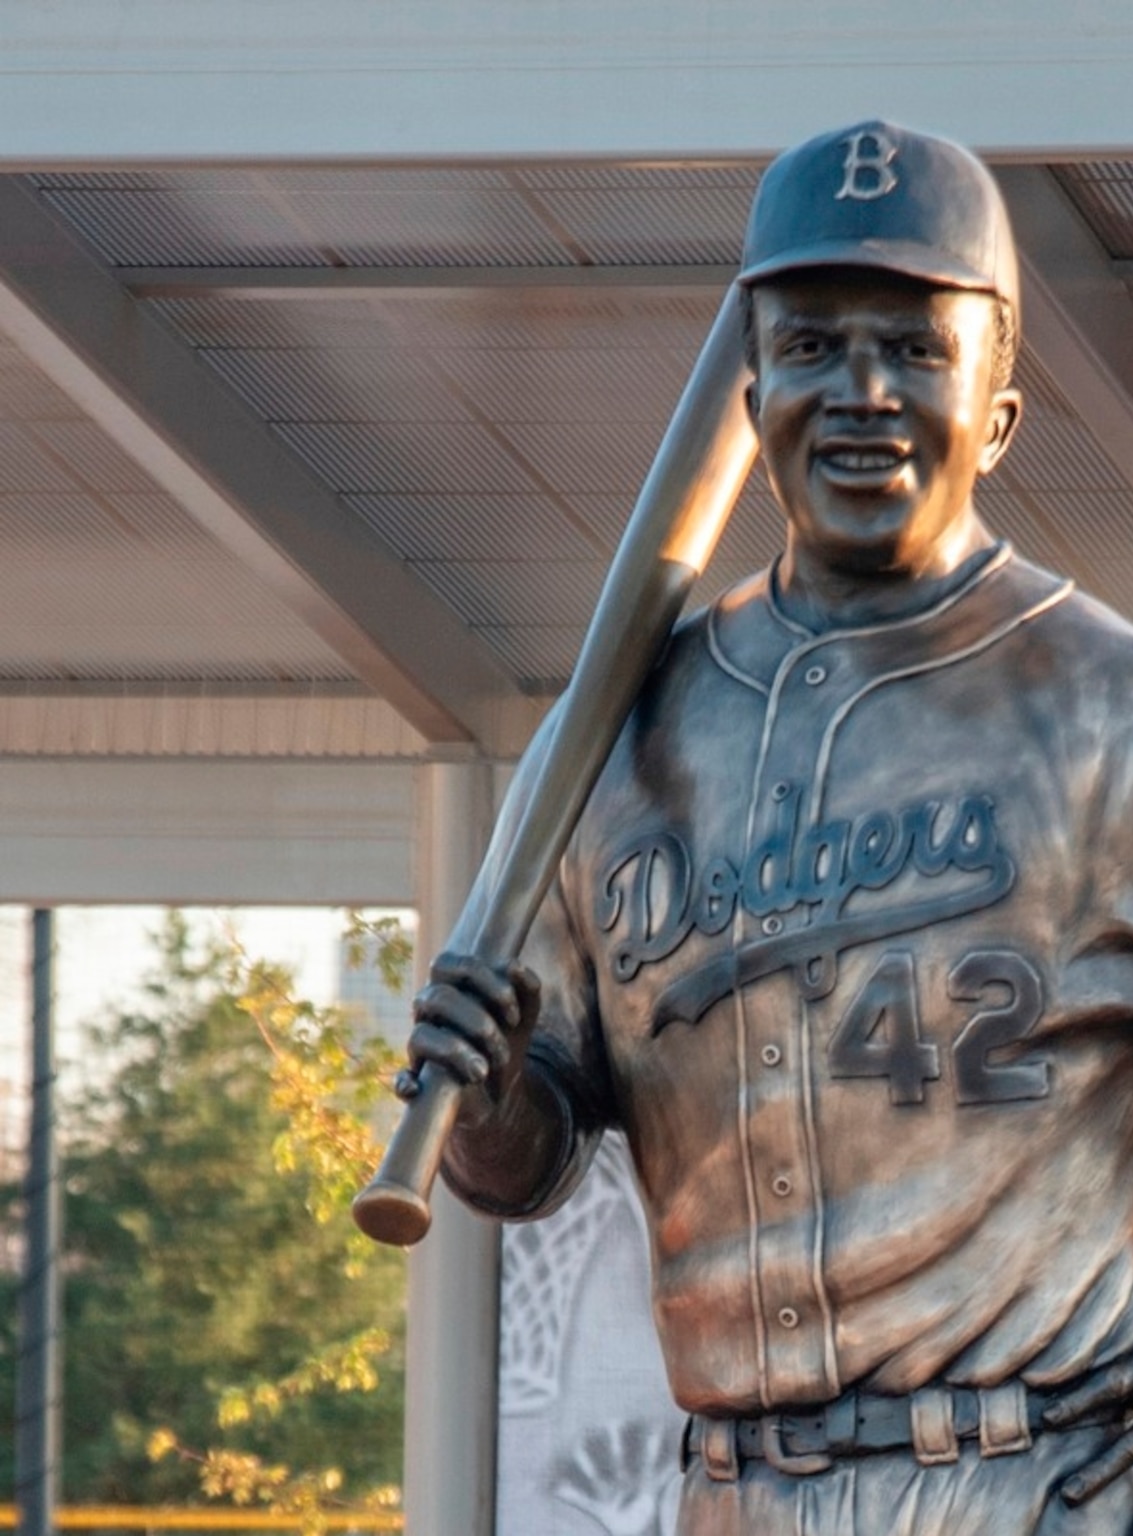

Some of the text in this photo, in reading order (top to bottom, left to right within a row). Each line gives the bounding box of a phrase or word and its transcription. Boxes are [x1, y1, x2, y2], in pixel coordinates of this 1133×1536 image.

[834, 131, 898, 200] B
[600, 783, 1017, 1005] Dodgers
[828, 949, 1050, 1106] 42
